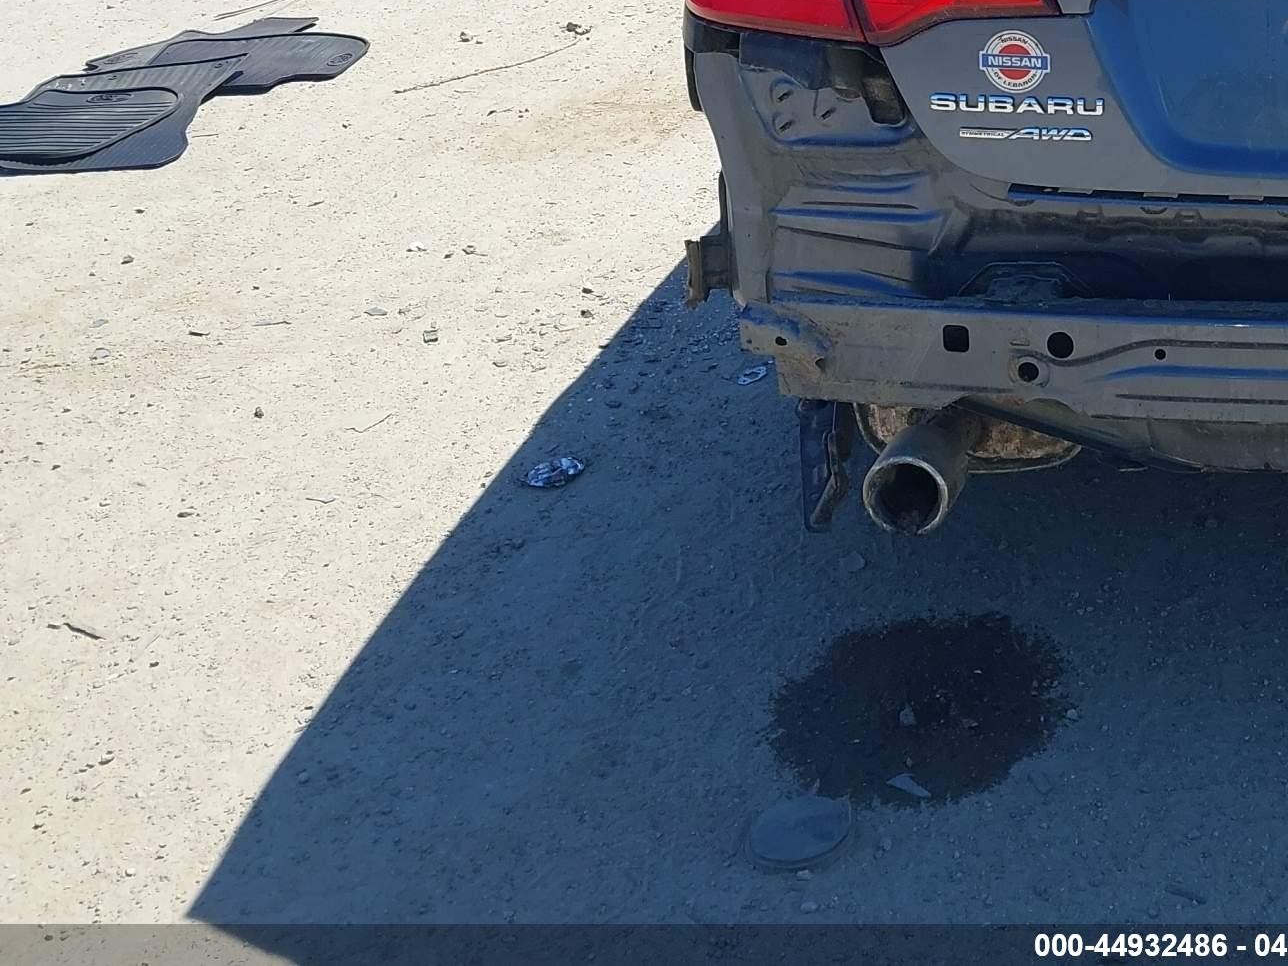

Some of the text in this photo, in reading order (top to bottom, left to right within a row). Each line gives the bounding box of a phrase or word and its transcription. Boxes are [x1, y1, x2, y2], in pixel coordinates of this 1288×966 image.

[987, 55, 1042, 68] NISSAN
[1002, 72, 1038, 88] LEBANON
[929, 92, 1104, 116] SUBARU
[1008, 127, 1093, 141] AWD
